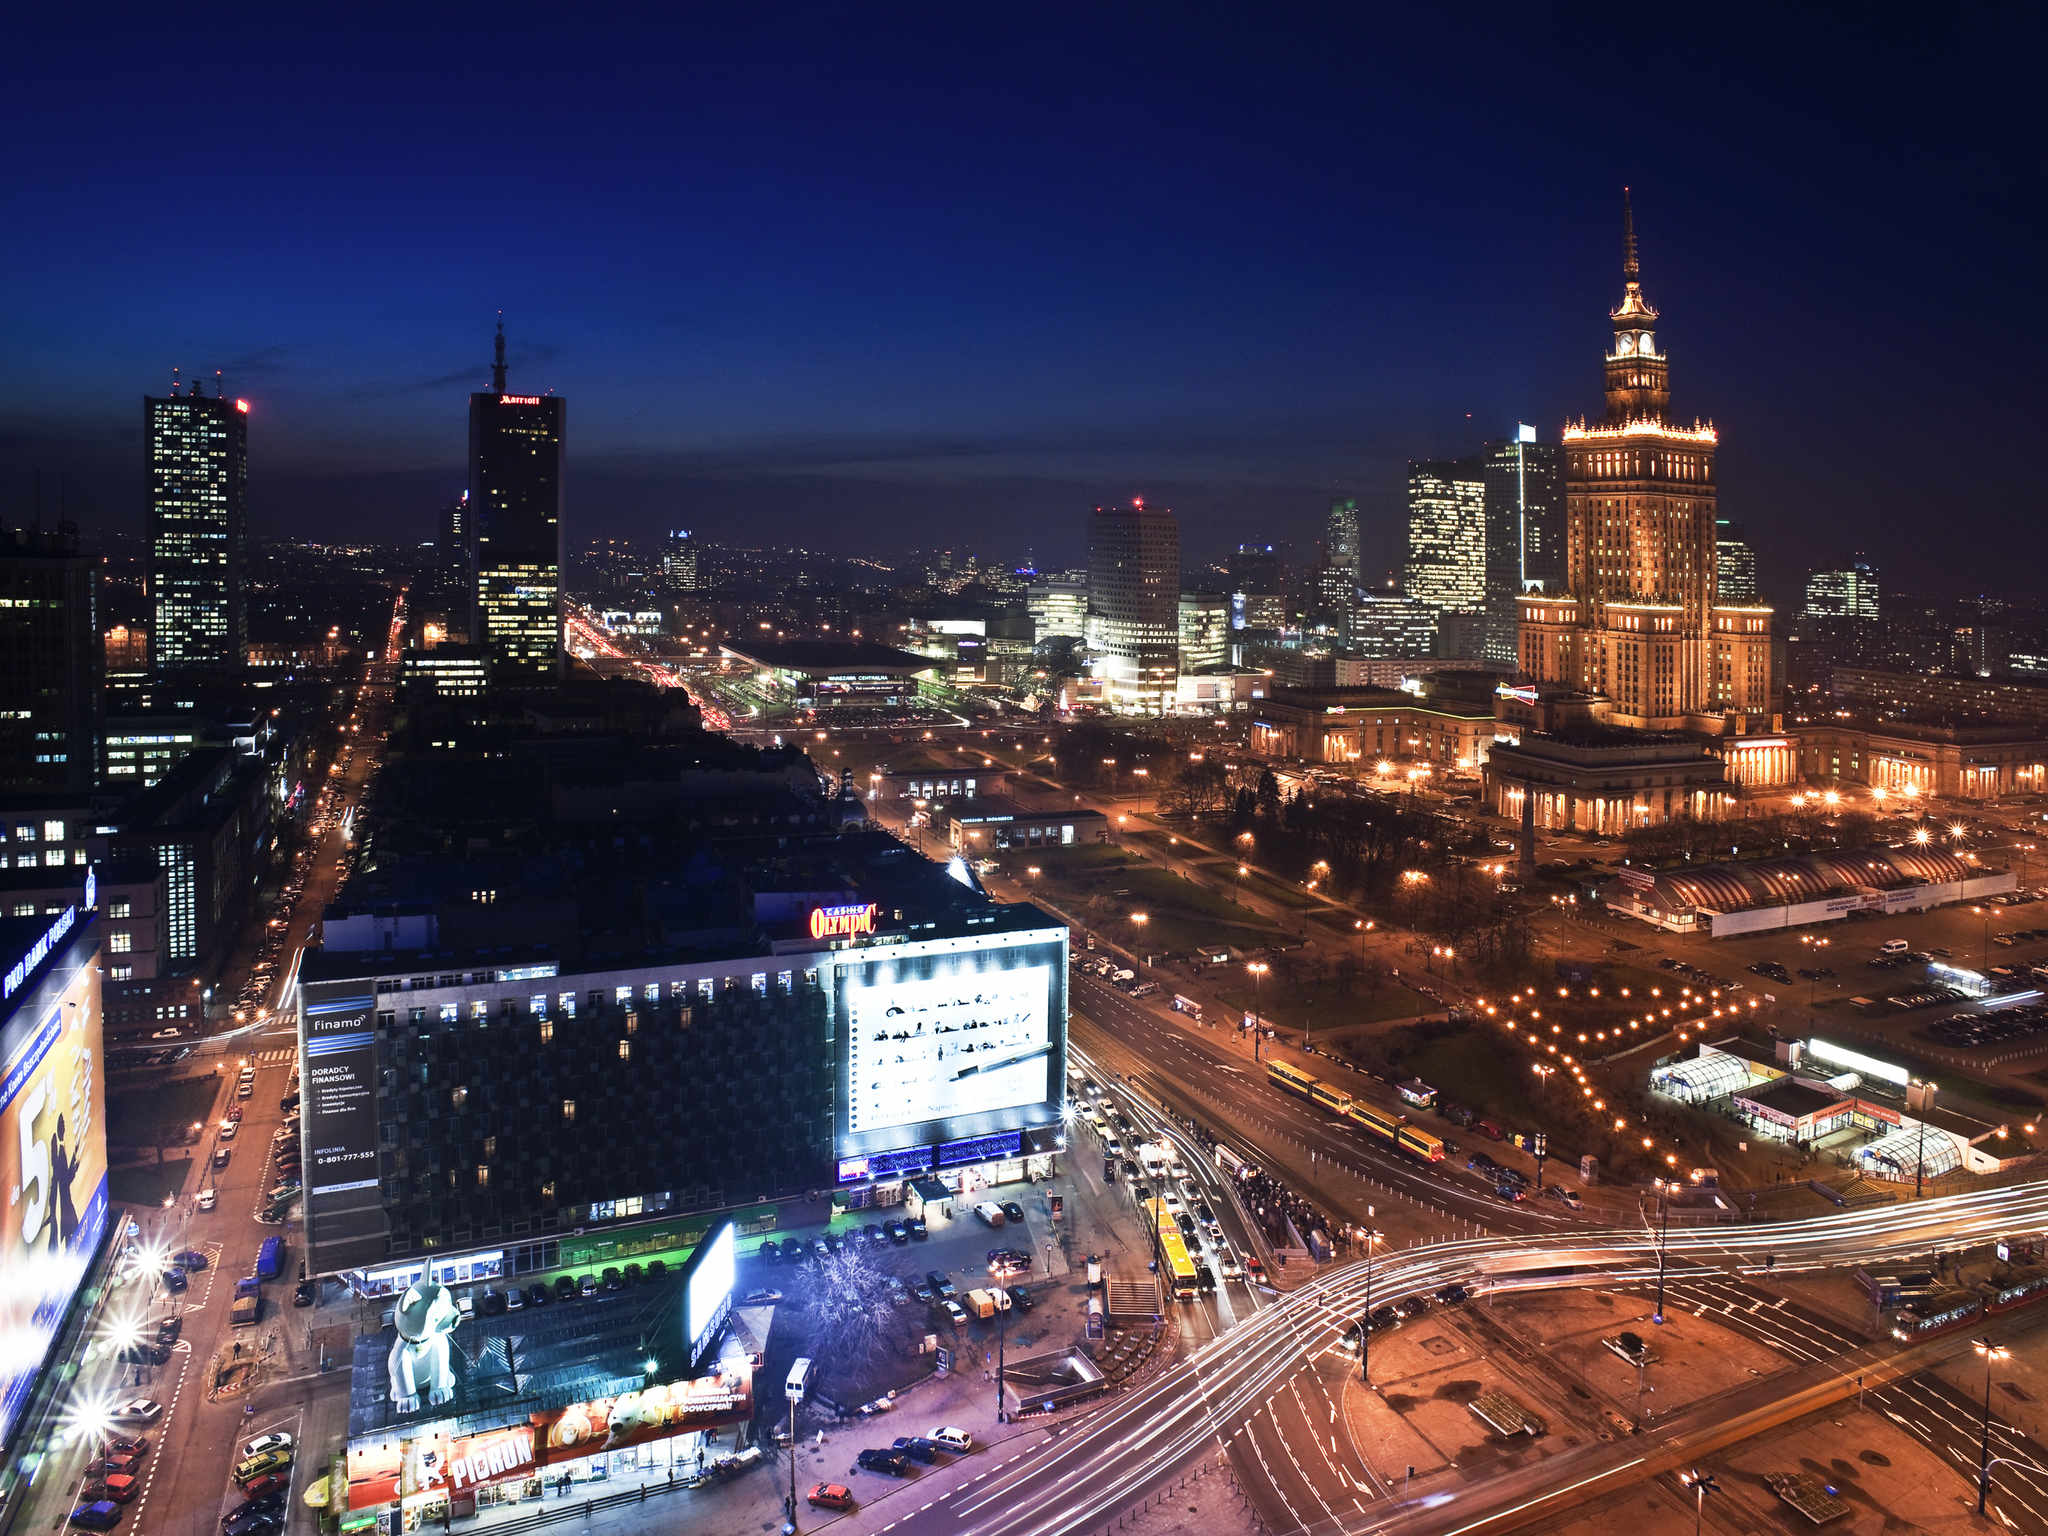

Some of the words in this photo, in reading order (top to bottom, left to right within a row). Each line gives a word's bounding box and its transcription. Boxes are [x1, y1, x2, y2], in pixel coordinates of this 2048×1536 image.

[500, 395, 540, 405] Marriott
[826, 906, 864, 916] CASINO
[4, 962, 24, 999] PKO
[24, 933, 48, 976] BANK
[48, 905, 75, 949] POLSKI
[312, 1066, 349, 1076] DORADCY
[312, 1074, 355, 1084] FINANSOWI
[314, 1146, 345, 1155] INFOLINIA
[318, 1151, 375, 1164] 0-801-777-555
[691, 1293, 732, 1368] SAMSUNG
[451, 1433, 532, 1489] PIORUN
